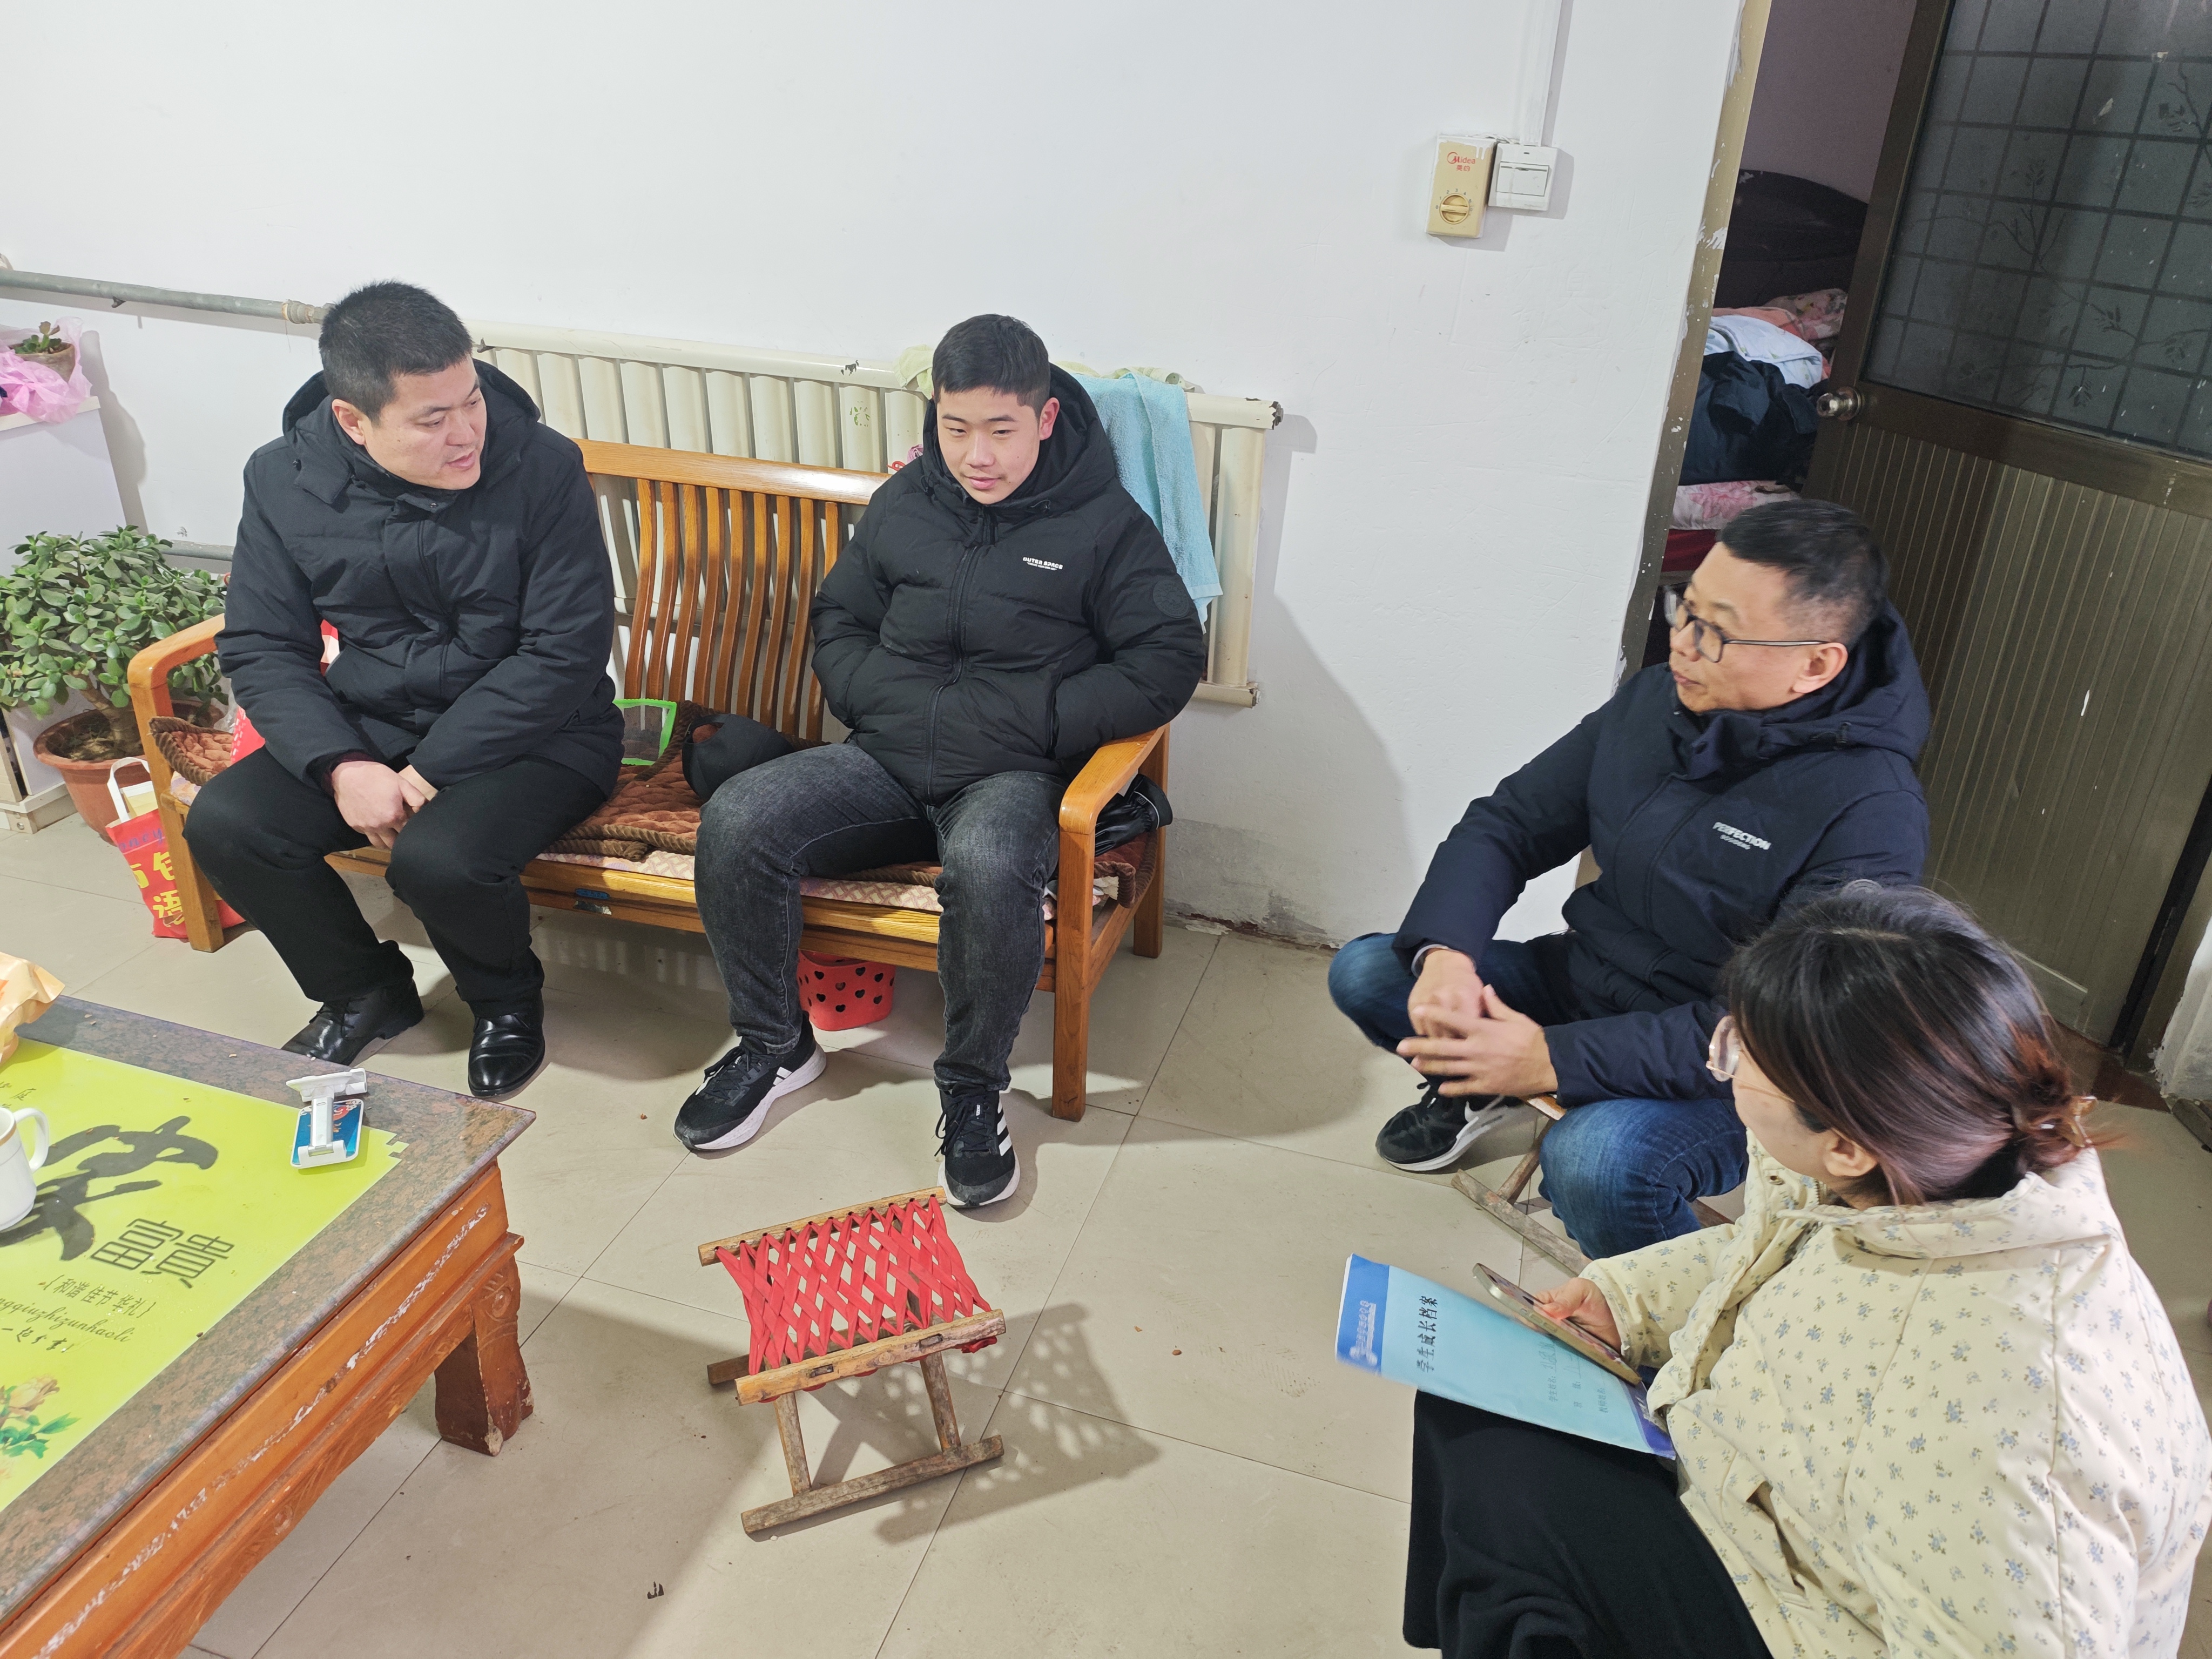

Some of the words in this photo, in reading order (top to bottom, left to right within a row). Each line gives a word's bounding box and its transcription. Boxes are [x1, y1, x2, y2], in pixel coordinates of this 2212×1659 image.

[1447, 152, 1475, 164] Midea
[1022, 557, 1043, 565] OUTER
[1043, 561, 1063, 570] SPACE
[1712, 821, 1772, 850] PERFECTION
[1417, 1296, 1438, 1373] 学生成长档案
